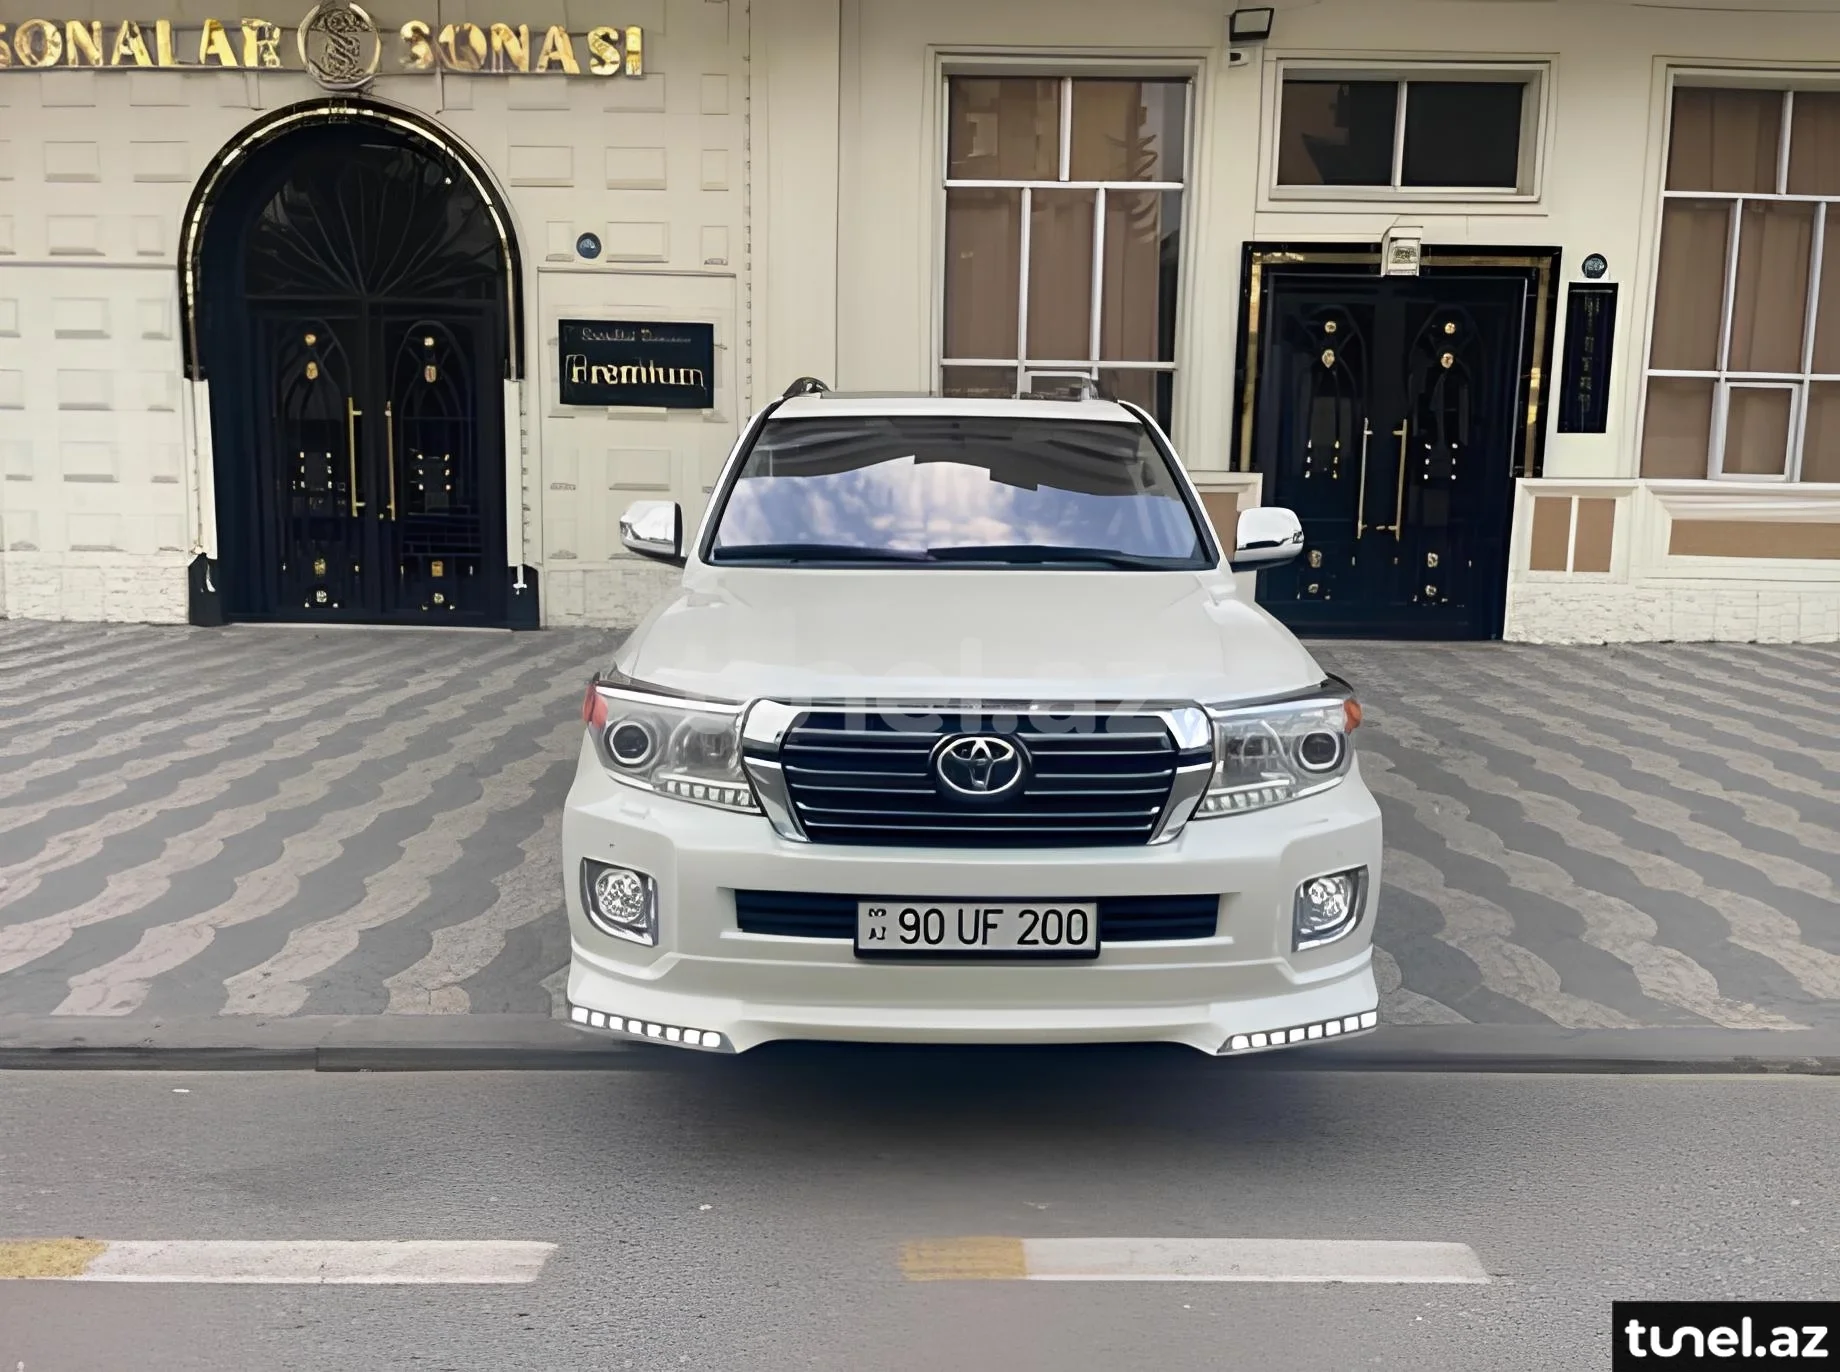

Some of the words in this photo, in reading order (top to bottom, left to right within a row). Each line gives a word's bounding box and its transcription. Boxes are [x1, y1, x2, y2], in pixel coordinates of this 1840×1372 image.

[400, 20, 642, 75] SONASI
[899, 908, 945, 945] 90
[958, 909, 1003, 945] UF
[1017, 909, 1088, 945] 200
